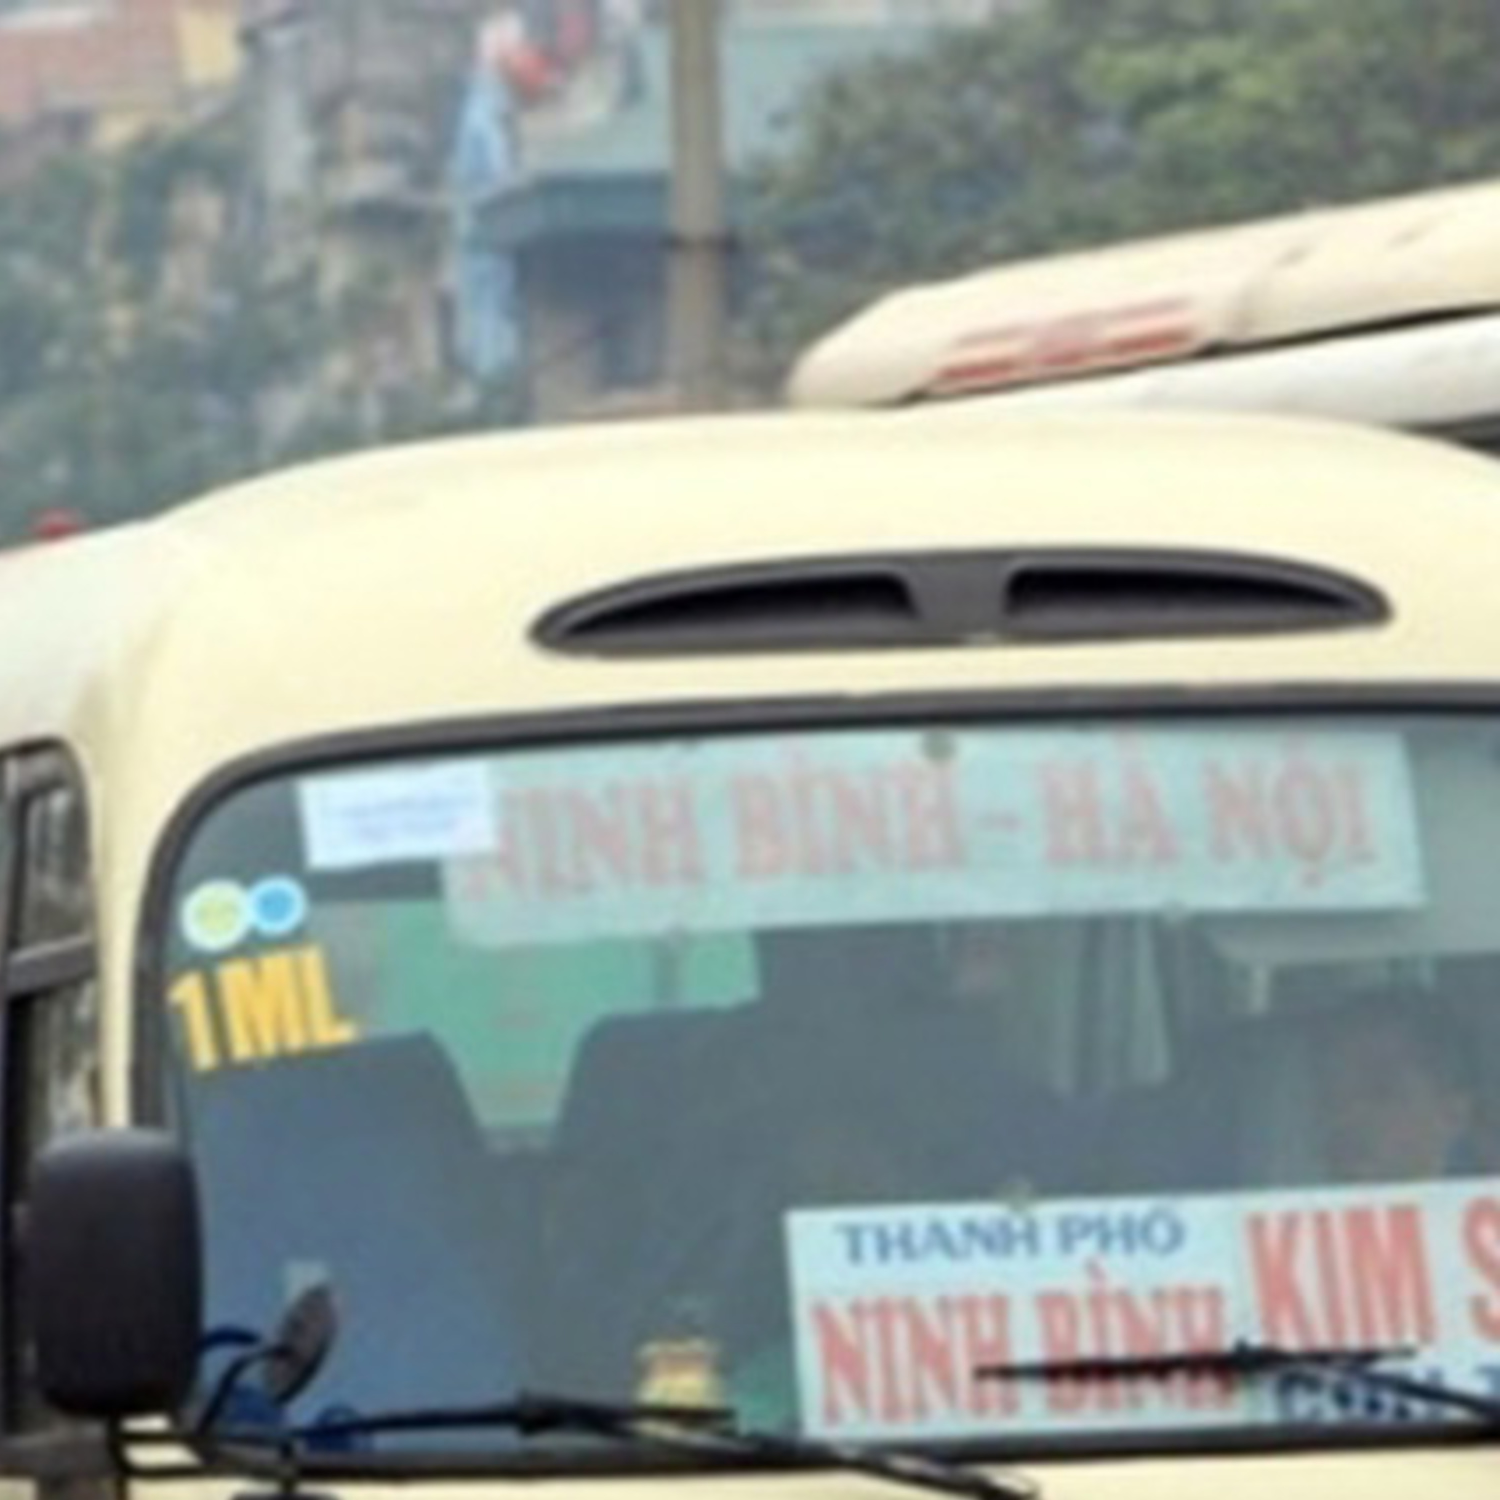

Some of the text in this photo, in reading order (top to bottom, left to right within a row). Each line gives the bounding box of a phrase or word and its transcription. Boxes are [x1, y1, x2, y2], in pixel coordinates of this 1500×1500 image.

[834, 1214, 1040, 1265] THANH
[1245, 1204, 1438, 1349] KIM
[810, 1293, 1021, 1428] NINH
